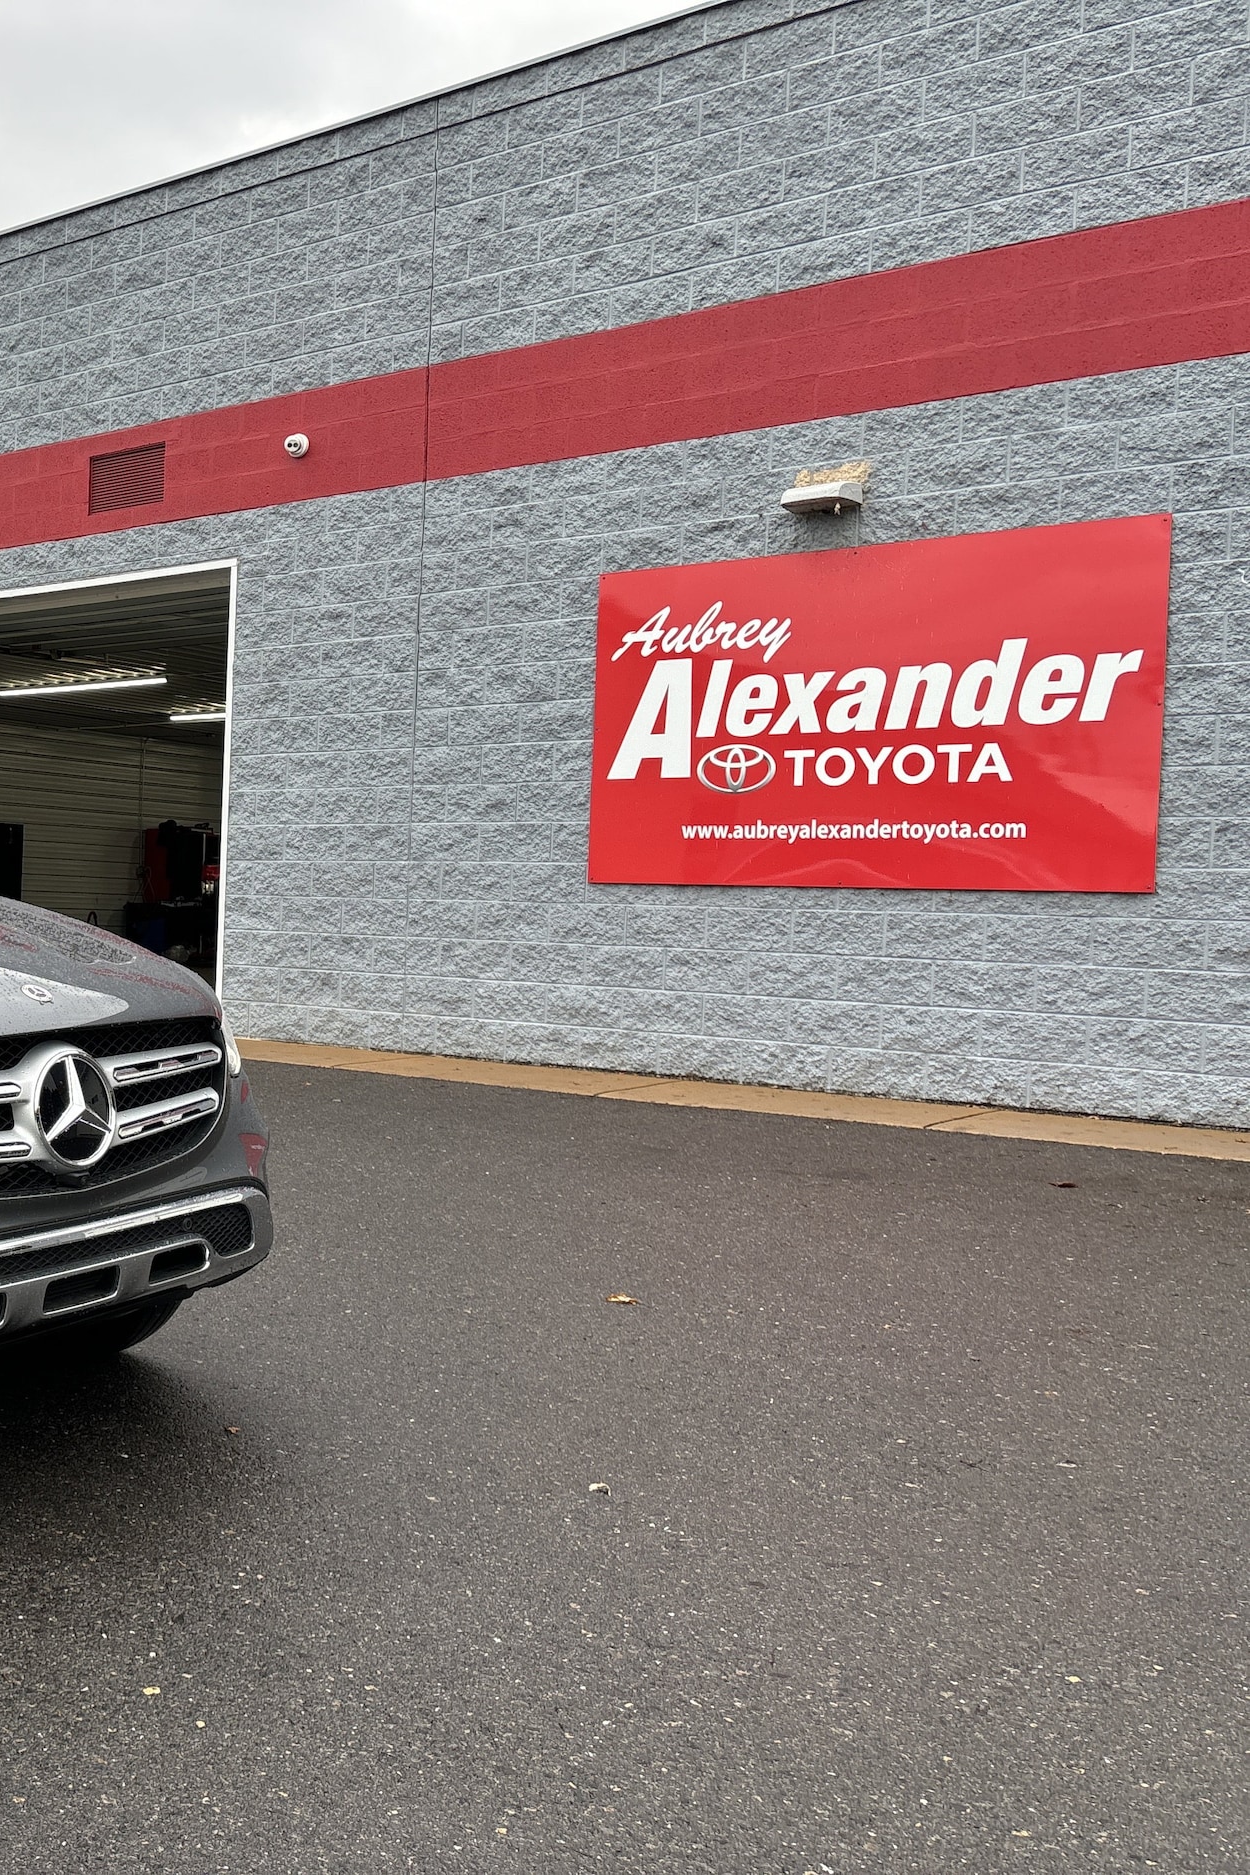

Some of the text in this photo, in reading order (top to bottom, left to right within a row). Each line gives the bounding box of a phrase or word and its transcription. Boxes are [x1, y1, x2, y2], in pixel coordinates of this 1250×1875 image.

[610, 600, 792, 664] Aubrey
[606, 637, 1145, 781] Alexander
[782, 742, 1014, 788] TOYOTA
[680, 818, 1028, 845] www.aubreyalexandertoyota.com
